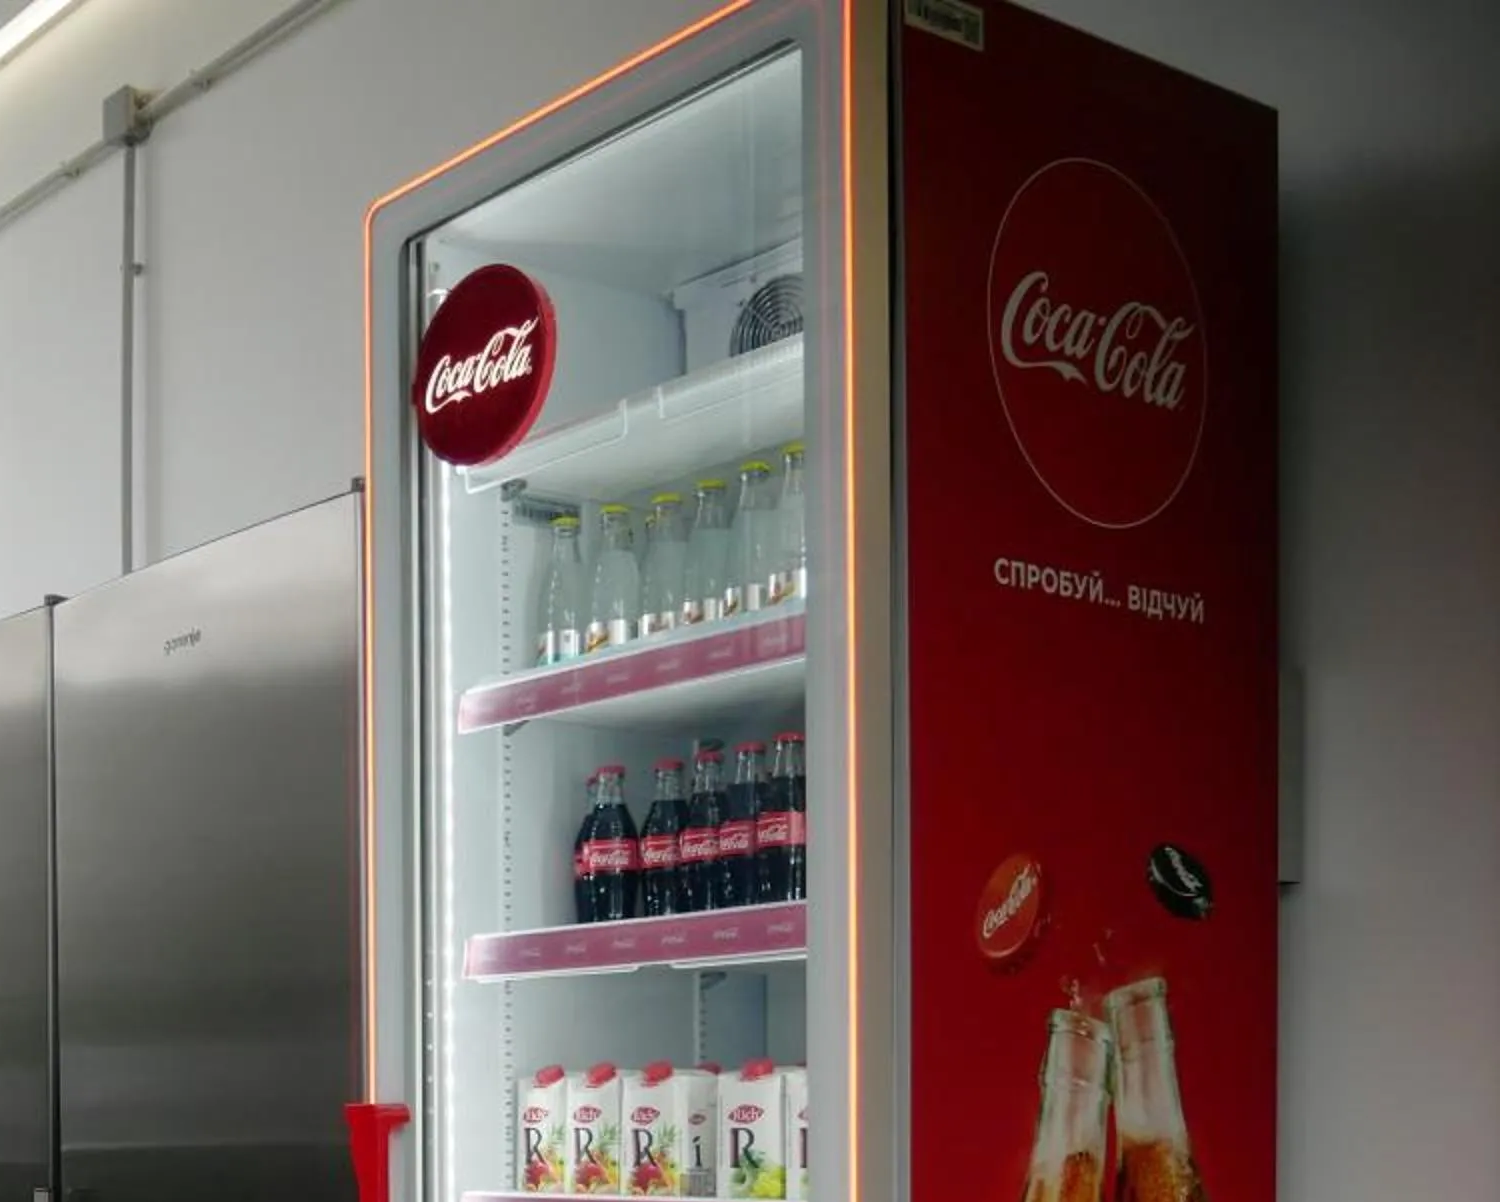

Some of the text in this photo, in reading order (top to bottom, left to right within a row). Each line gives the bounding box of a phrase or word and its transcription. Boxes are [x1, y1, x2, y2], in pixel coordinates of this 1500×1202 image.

[425, 315, 539, 414] Coca-Cola
[1001, 271, 1196, 411] Coca-Cola
[994, 557, 1205, 625] СПРОБУЙ... ВІДЧУЙ
